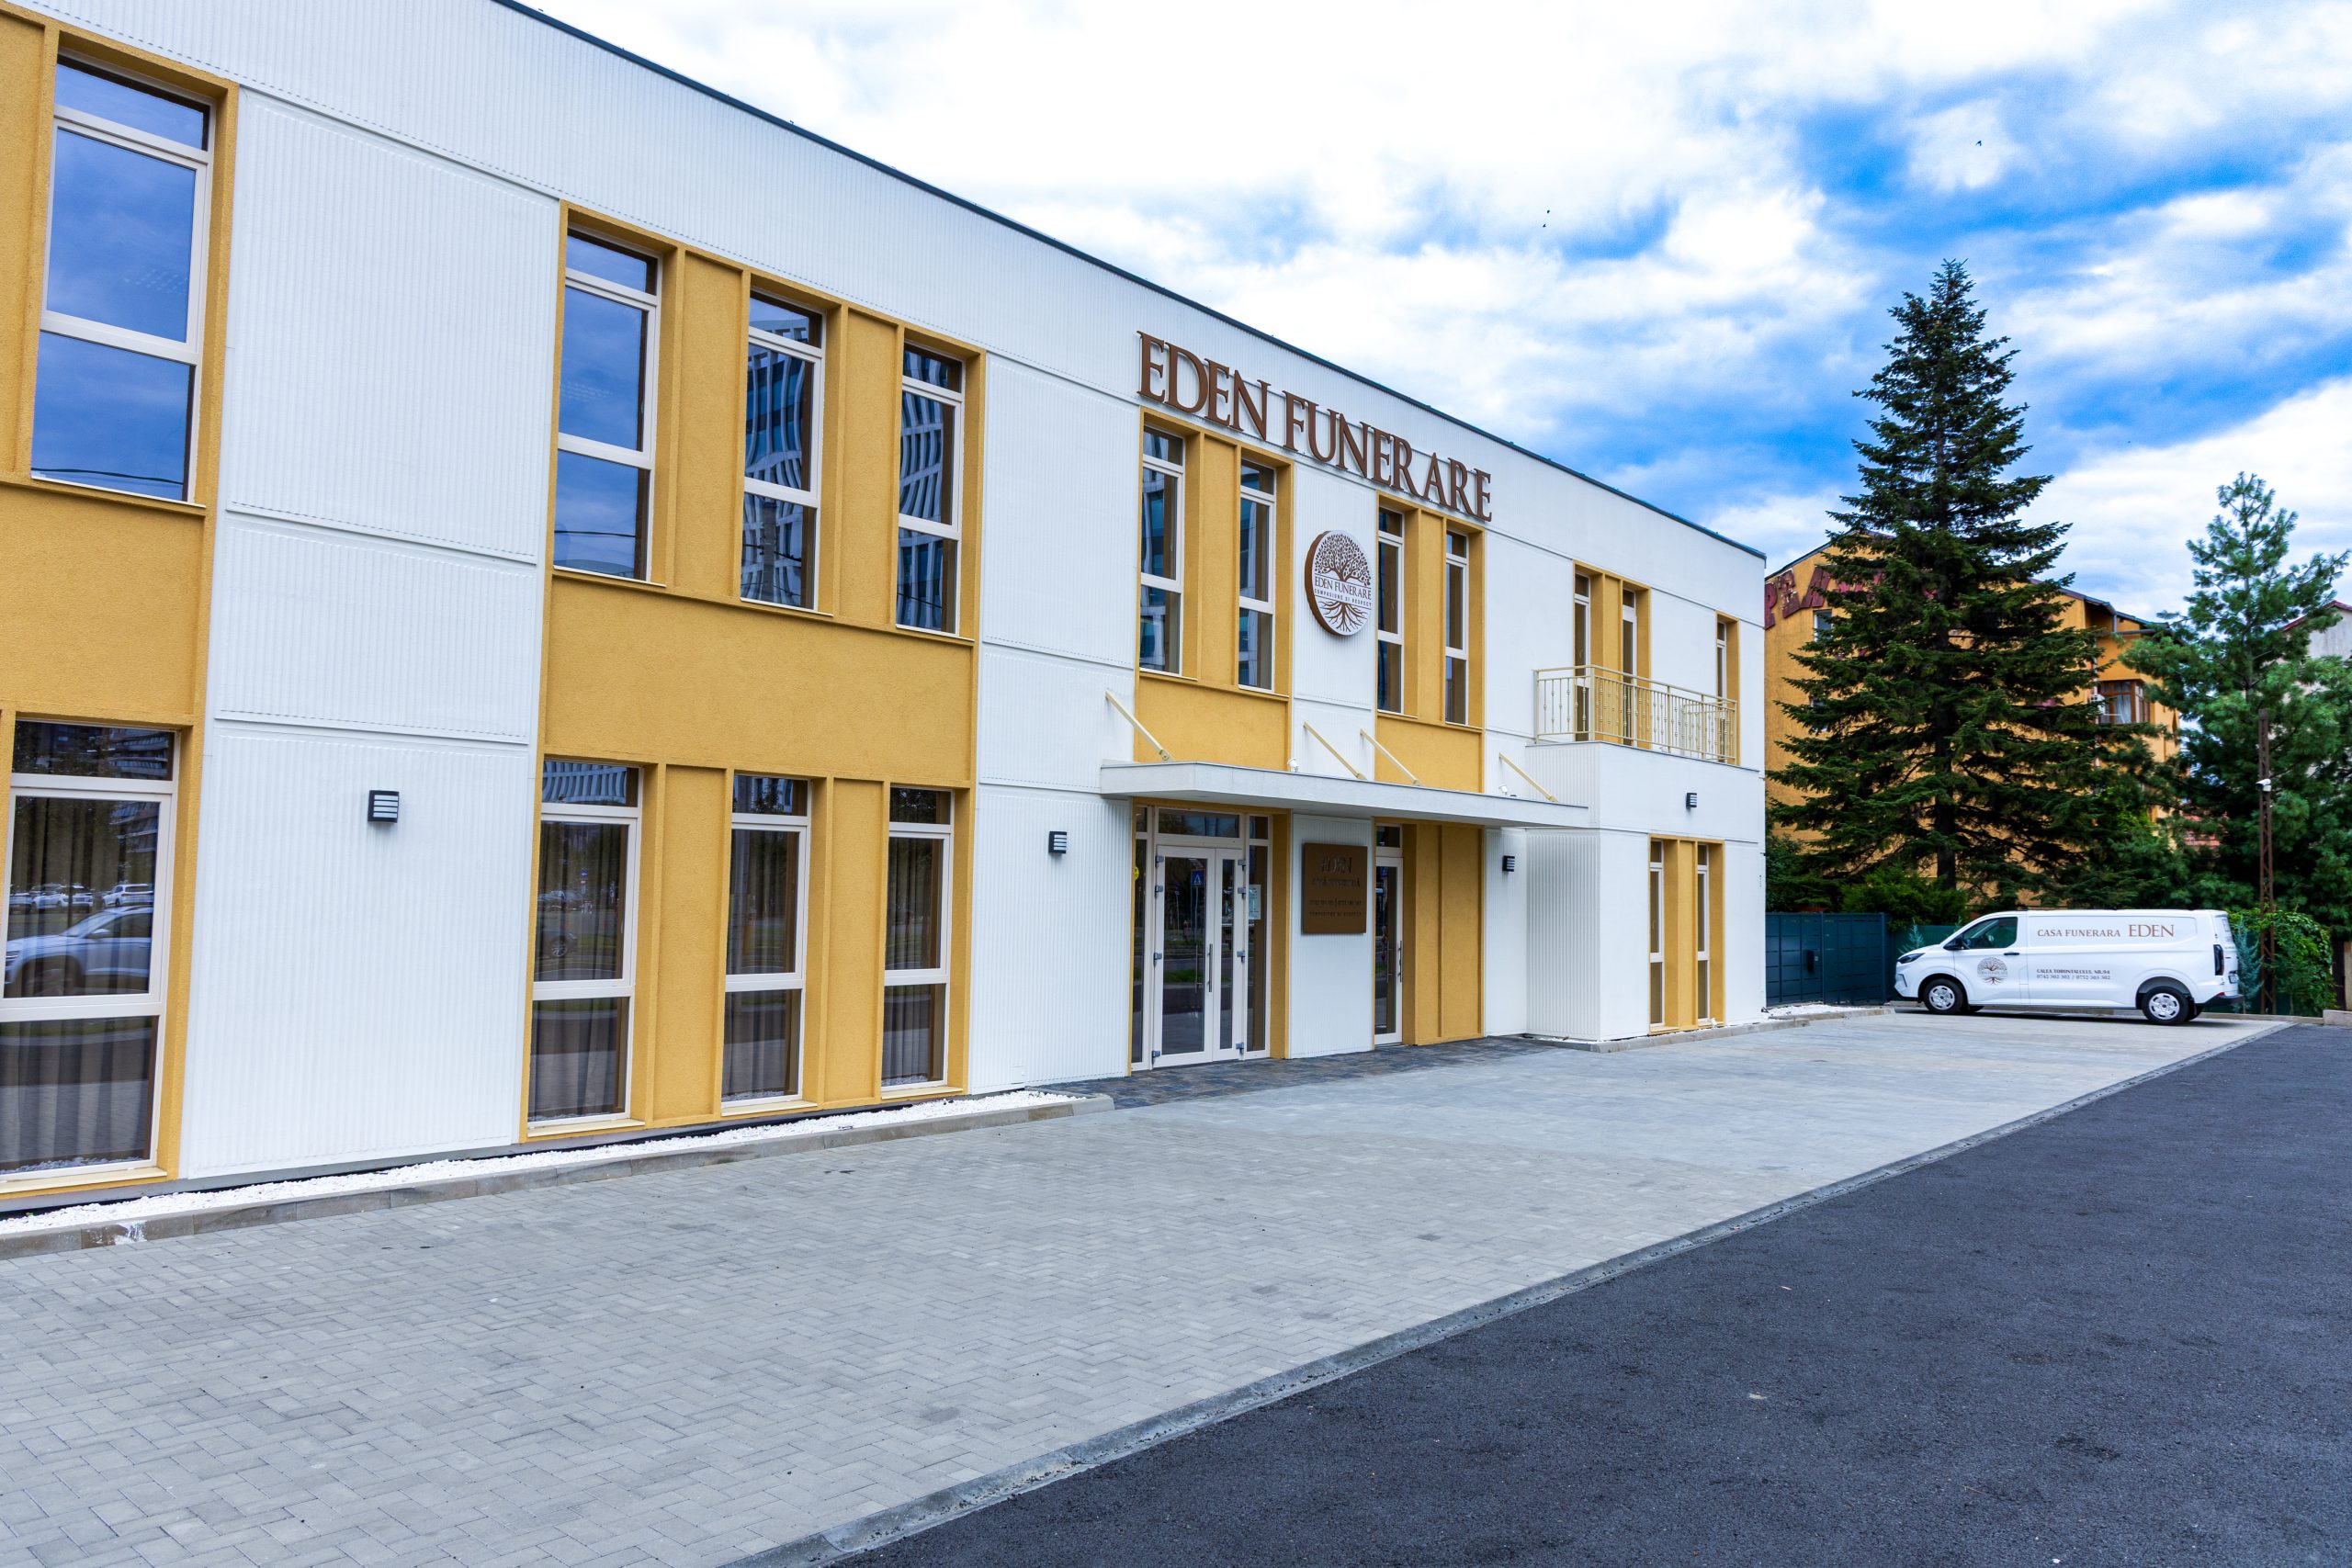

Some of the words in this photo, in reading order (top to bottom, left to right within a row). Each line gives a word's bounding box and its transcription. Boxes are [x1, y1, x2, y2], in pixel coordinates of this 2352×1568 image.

[1136, 330, 1272, 442] EDEN
[1282, 389, 1493, 523] FUNERARE
[1315, 576, 1333, 591] EDEN
[1334, 581, 1372, 601] FUNERARE
[2037, 929, 2063, 937] CASA
[2065, 929, 2121, 937] FUNERARA
[2128, 924, 2175, 938] EDEN
